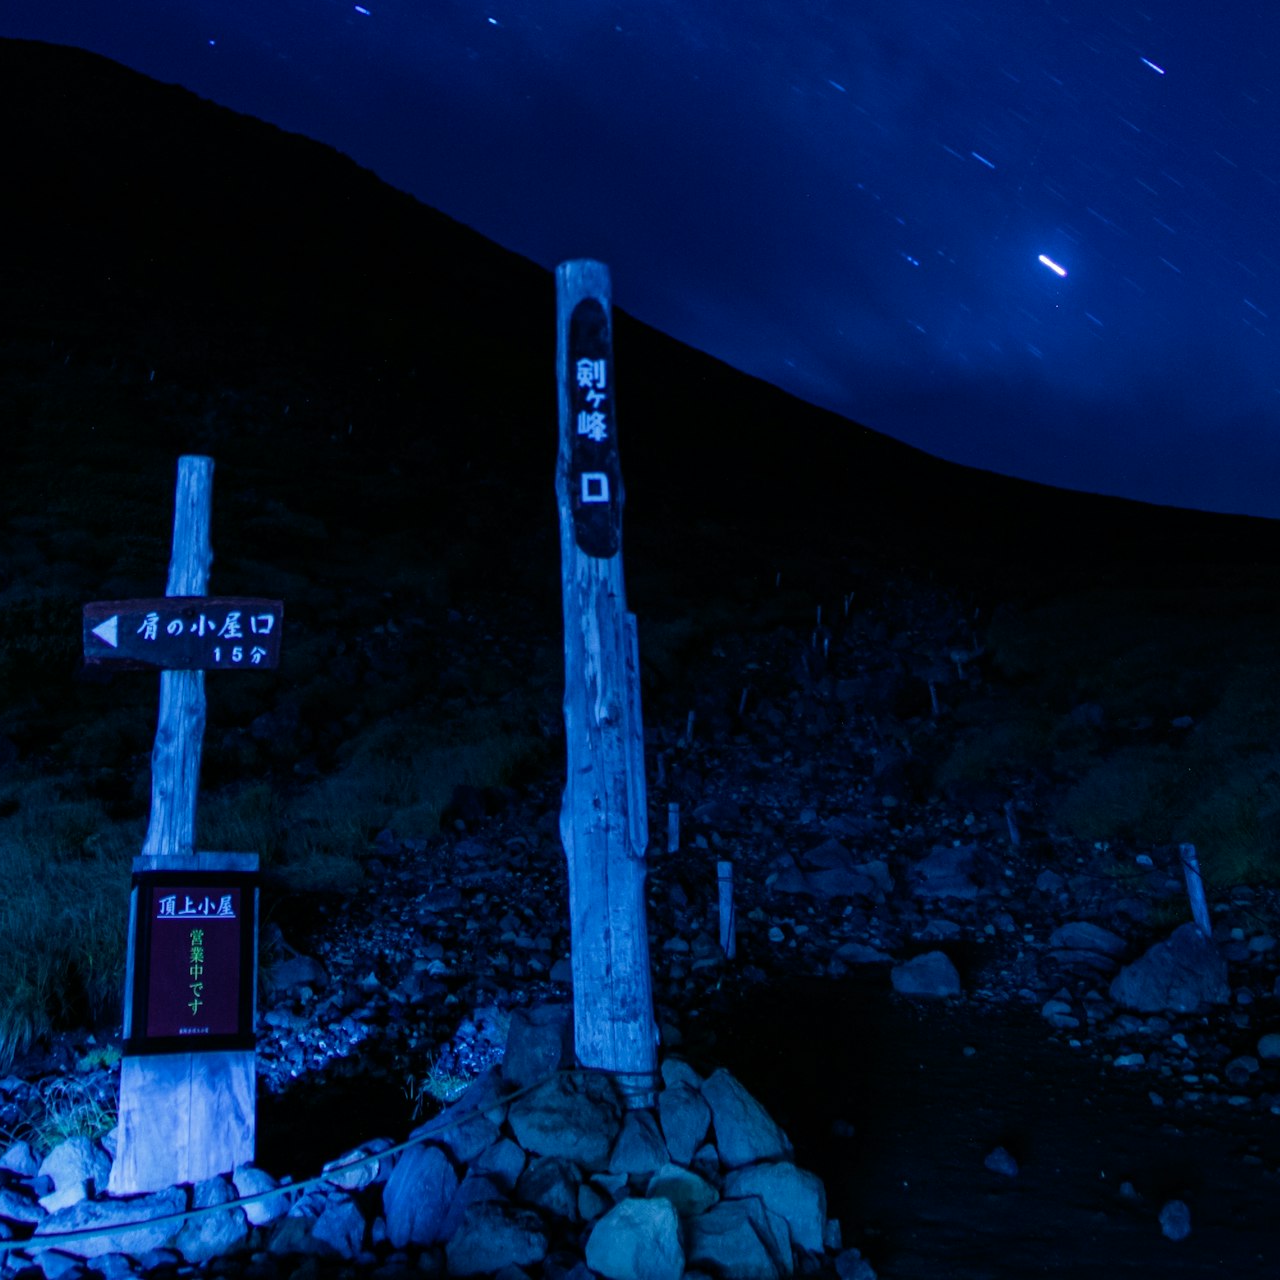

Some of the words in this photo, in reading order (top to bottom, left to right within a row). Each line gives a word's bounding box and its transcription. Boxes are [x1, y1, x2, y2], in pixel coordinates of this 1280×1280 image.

[136, 611, 275, 640] 肩の小屋口
[158, 894, 234, 916] 頂上小屋
[188, 928, 204, 1016] 営業中です
